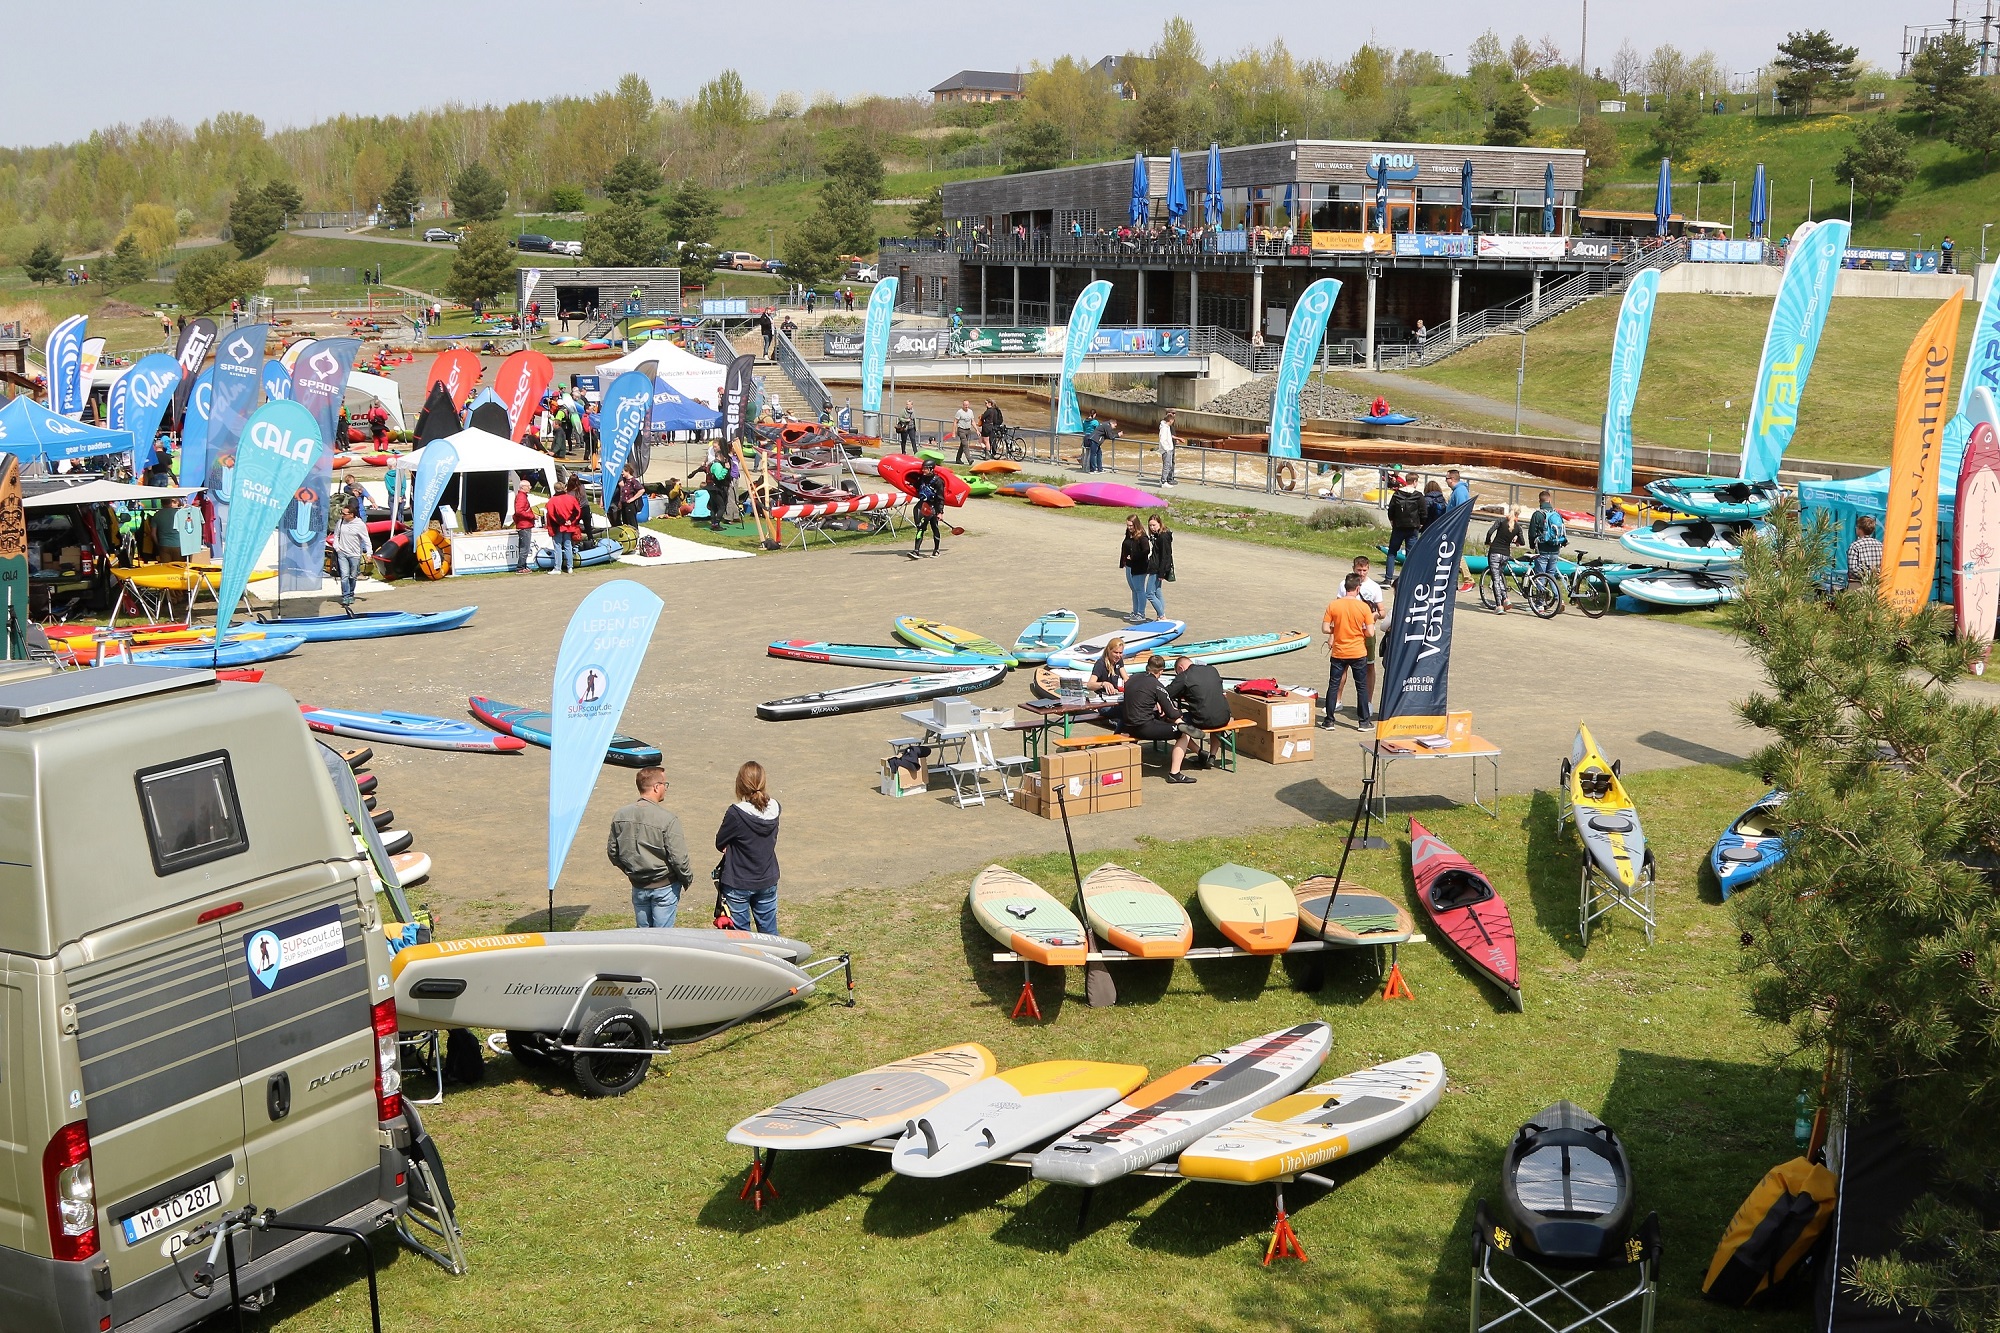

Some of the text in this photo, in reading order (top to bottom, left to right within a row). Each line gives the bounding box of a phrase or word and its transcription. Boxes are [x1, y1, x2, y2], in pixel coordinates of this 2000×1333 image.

[1584, 244, 1608, 257] CALA
[1859, 250, 1890, 260] GEÖFFNET
[829, 342, 860, 350] Venture
[835, 336, 850, 344] Lite
[909, 337, 938, 351] CALA
[220, 363, 257, 375] SPADE
[131, 371, 176, 408] Palm
[299, 379, 340, 394] SPADE
[726, 370, 743, 441] REBEL
[251, 421, 315, 465] CALA
[604, 411, 641, 477] Anfibio
[243, 480, 272, 496] FLOW
[242, 488, 281, 510] WITH IT.
[1815, 490, 1879, 505] SPINERA
[486, 544, 514, 553] Anfibio
[2, 570, 18, 582] CALA
[1895, 589, 1915, 597] Kajak
[603, 599, 629, 613] DAS
[1416, 541, 1456, 663] Venture
[1892, 597, 1919, 605] Surfski
[1404, 583, 1430, 644] Lite
[583, 616, 648, 633] LEBEN IST
[593, 636, 635, 651] SUPer!
[568, 704, 612, 714] SUPscout.de
[282, 926, 341, 954] SUPscout.de
[751, 932, 772, 941] FAST
[284, 938, 343, 963] SUP Spots und Touren
[591, 985, 625, 997] ULTRA
[308, 1057, 370, 1092] DUCATO
[140, 1185, 212, 1233] M TO 287
[170, 1234, 182, 1254] D
